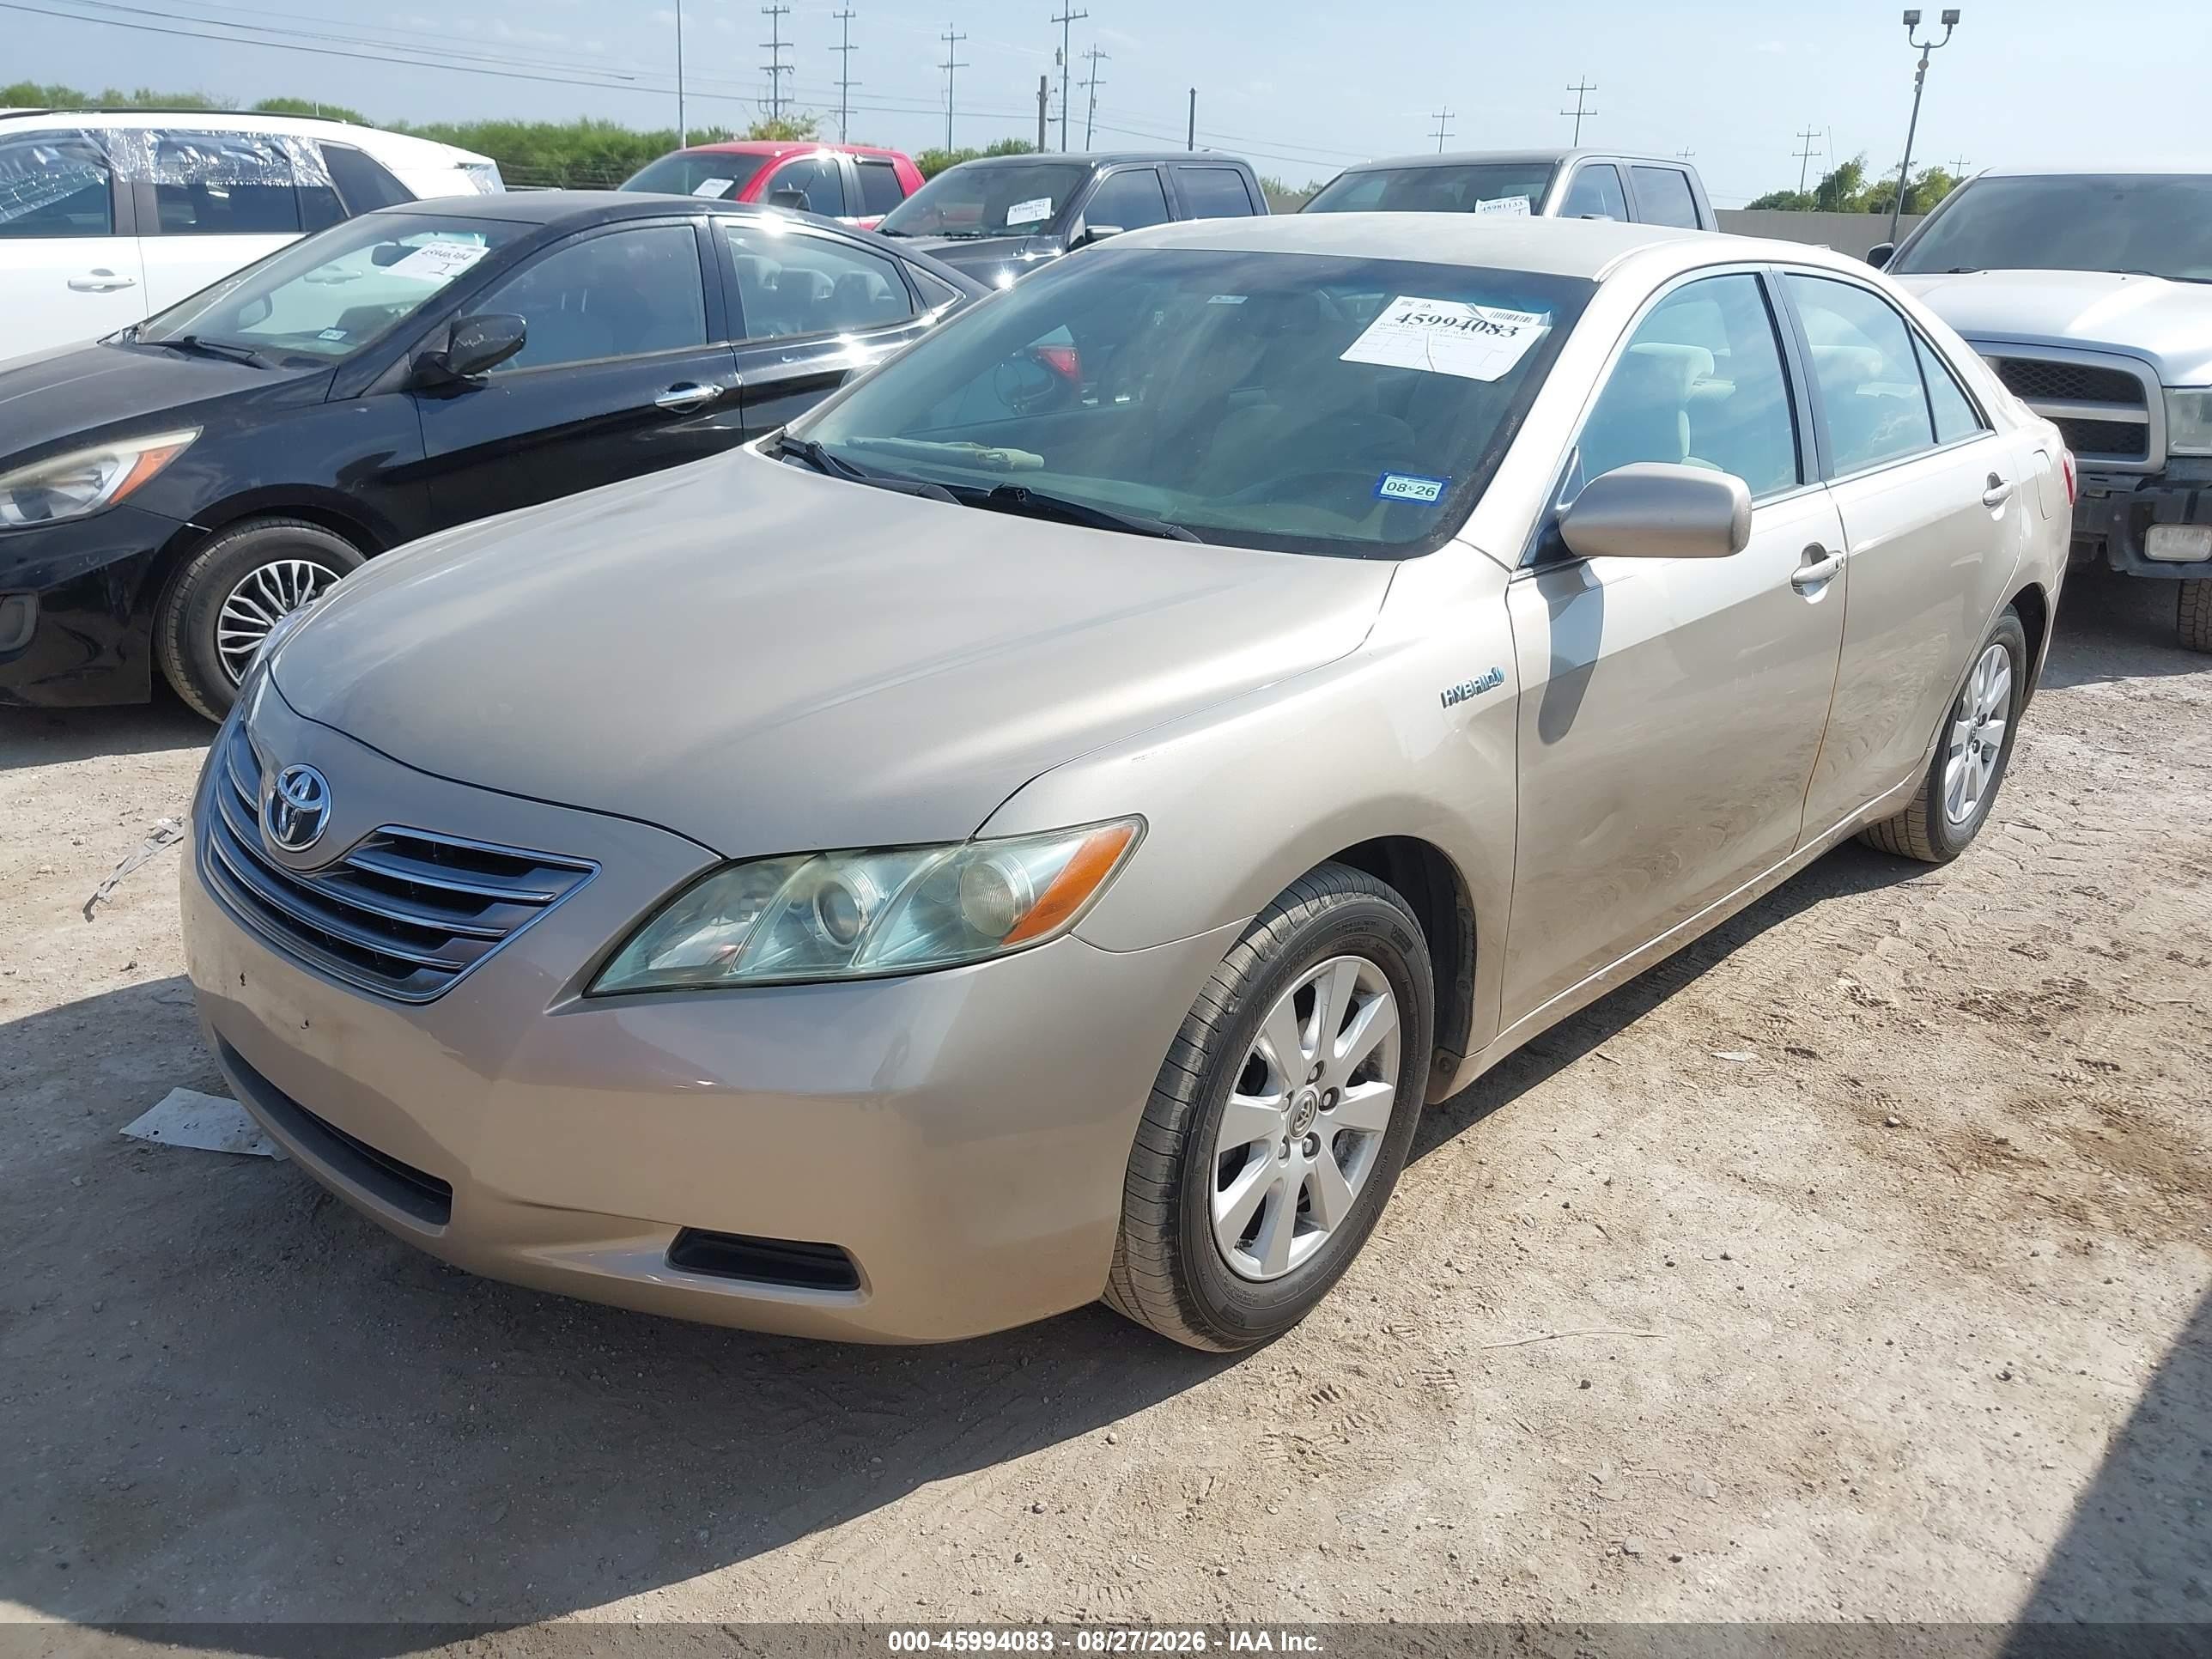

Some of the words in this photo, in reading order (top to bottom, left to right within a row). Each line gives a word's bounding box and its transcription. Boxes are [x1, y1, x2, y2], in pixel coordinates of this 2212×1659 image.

[1395, 312, 1519, 337] 45994083
[1386, 482, 1407, 493] 08
[1414, 485, 1437, 496] 26
[1441, 666, 1505, 708] HYBRID
